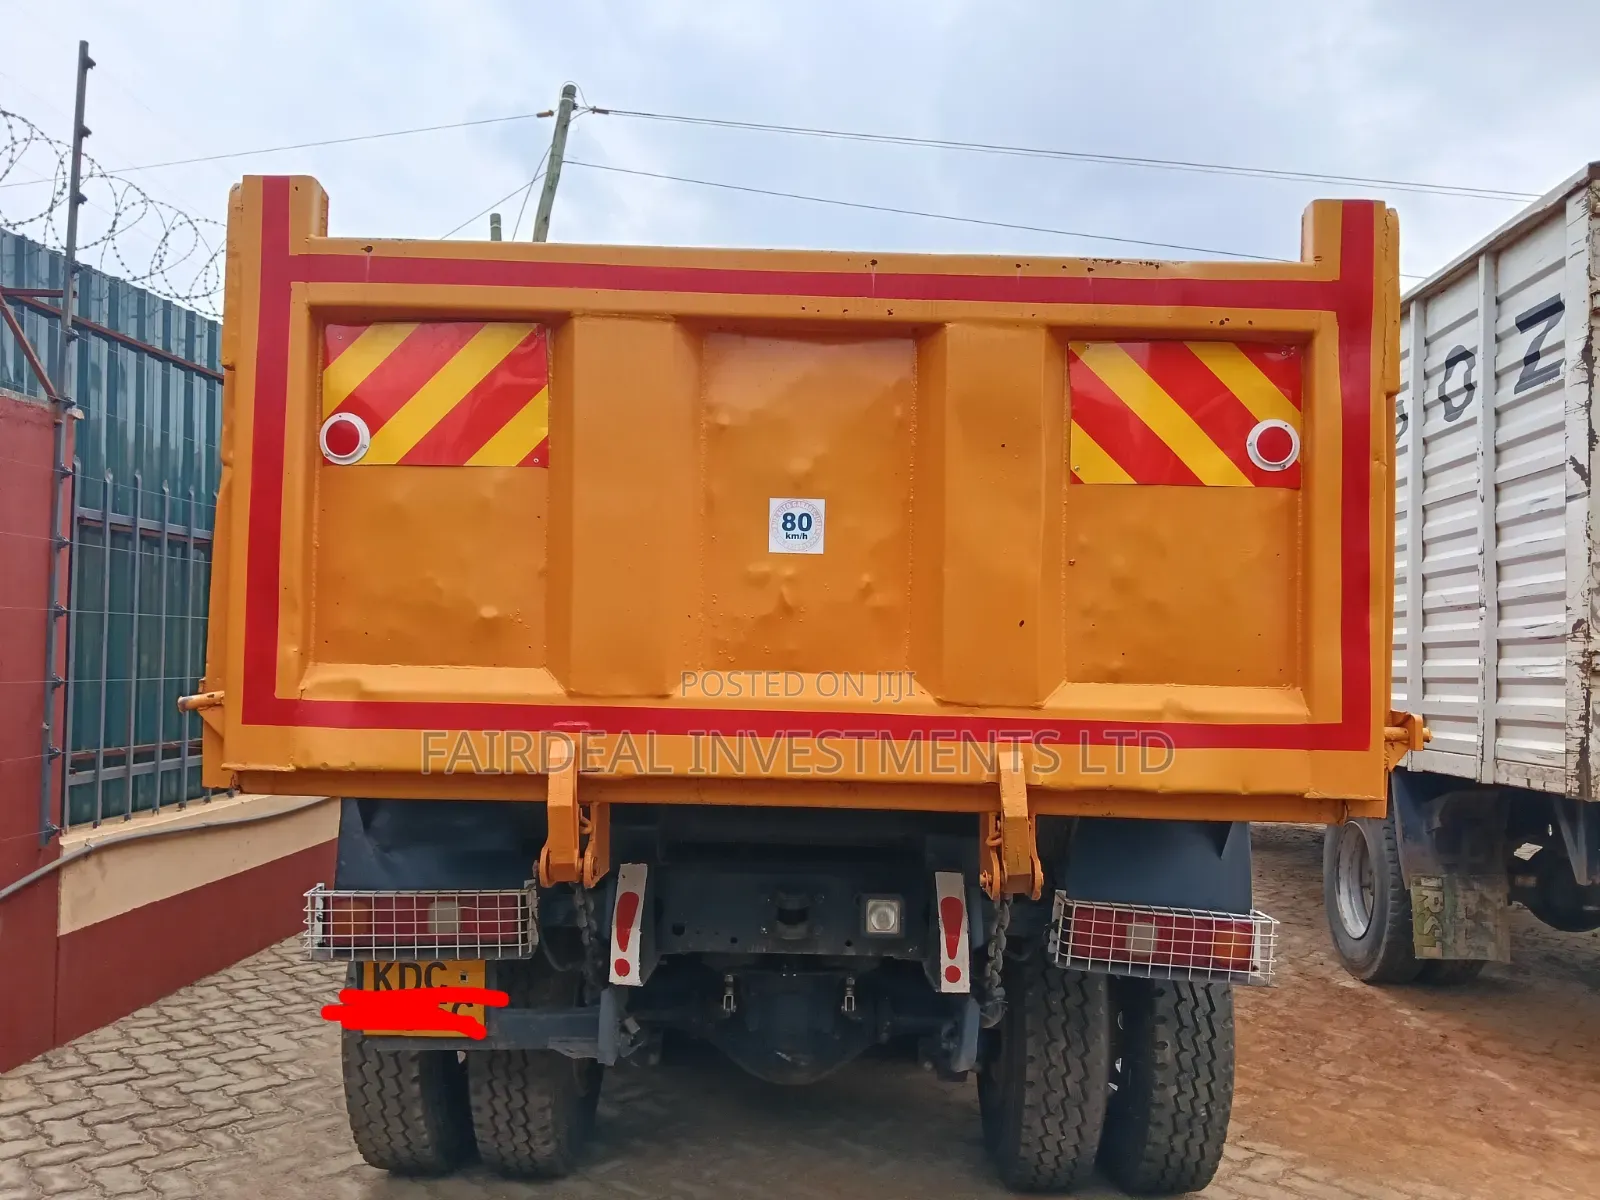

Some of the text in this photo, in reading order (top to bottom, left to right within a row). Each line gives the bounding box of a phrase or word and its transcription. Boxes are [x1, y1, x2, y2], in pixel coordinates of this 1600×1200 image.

[782, 512, 812, 531] 80
[785, 532, 808, 540] km/h
[374, 961, 447, 991] KDC
